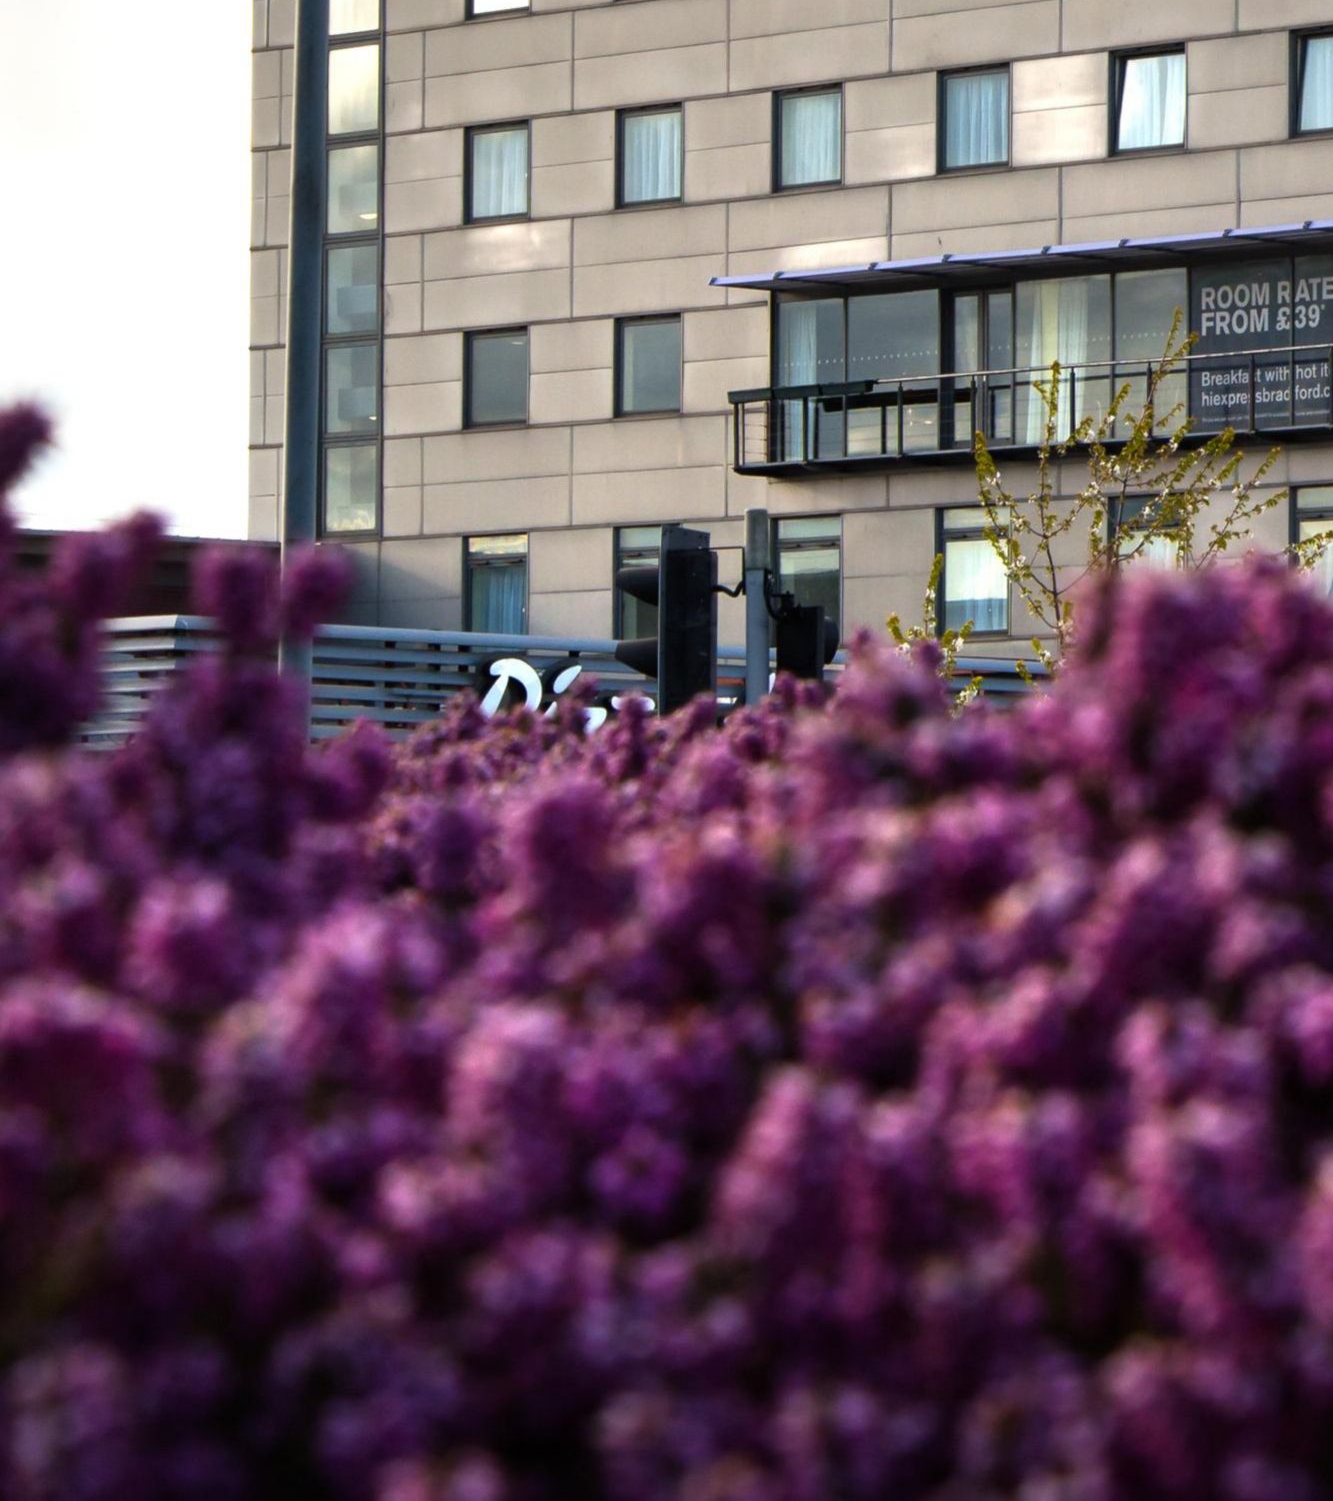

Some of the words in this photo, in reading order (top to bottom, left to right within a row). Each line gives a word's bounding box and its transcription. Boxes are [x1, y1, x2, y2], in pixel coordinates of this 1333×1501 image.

[1201, 281, 1270, 310] ROOM
[1201, 307, 1269, 336] FROM
[1201, 369, 1261, 387] Breakfat
[1264, 365, 1290, 383] with
[1295, 363, 1317, 380] hot
